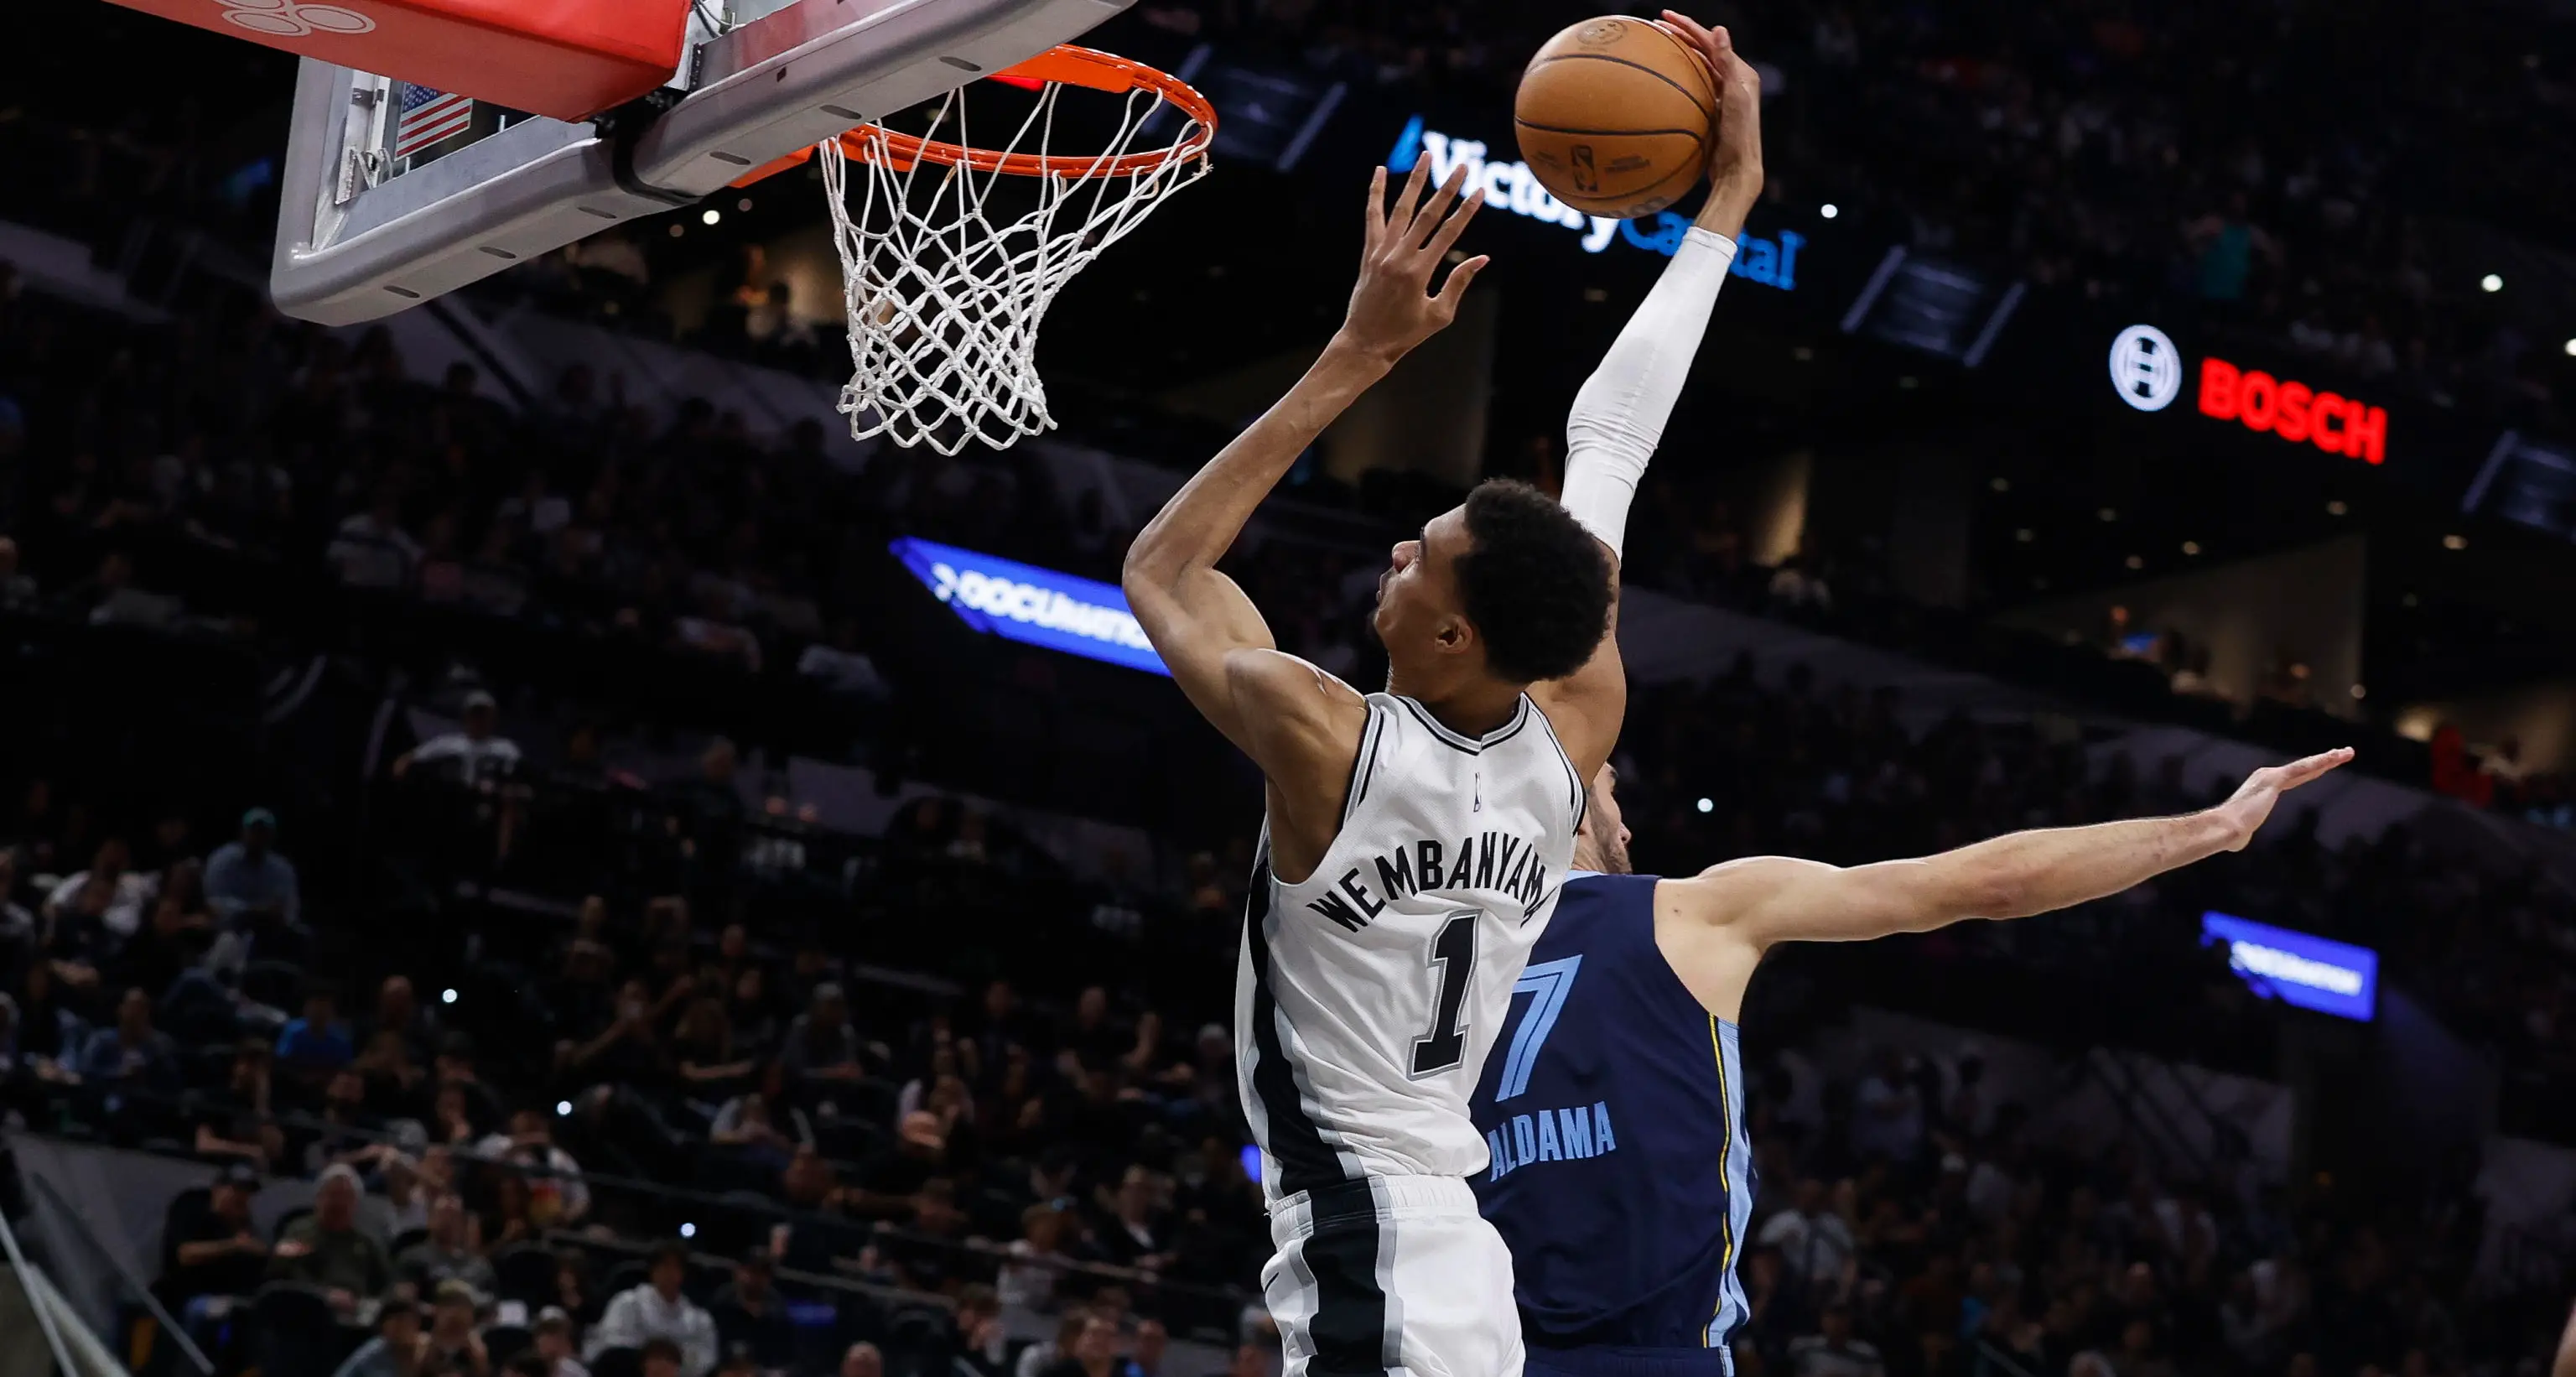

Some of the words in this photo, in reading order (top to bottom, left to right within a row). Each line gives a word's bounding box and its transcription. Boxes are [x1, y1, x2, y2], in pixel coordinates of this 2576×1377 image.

[1619, 209, 1807, 291] Catal
[2198, 356, 2387, 465] BOSCH
[1407, 908, 1483, 1082] 1
[1495, 954, 1584, 1103] 7
[1488, 1100, 1618, 1182] ALDAMA
